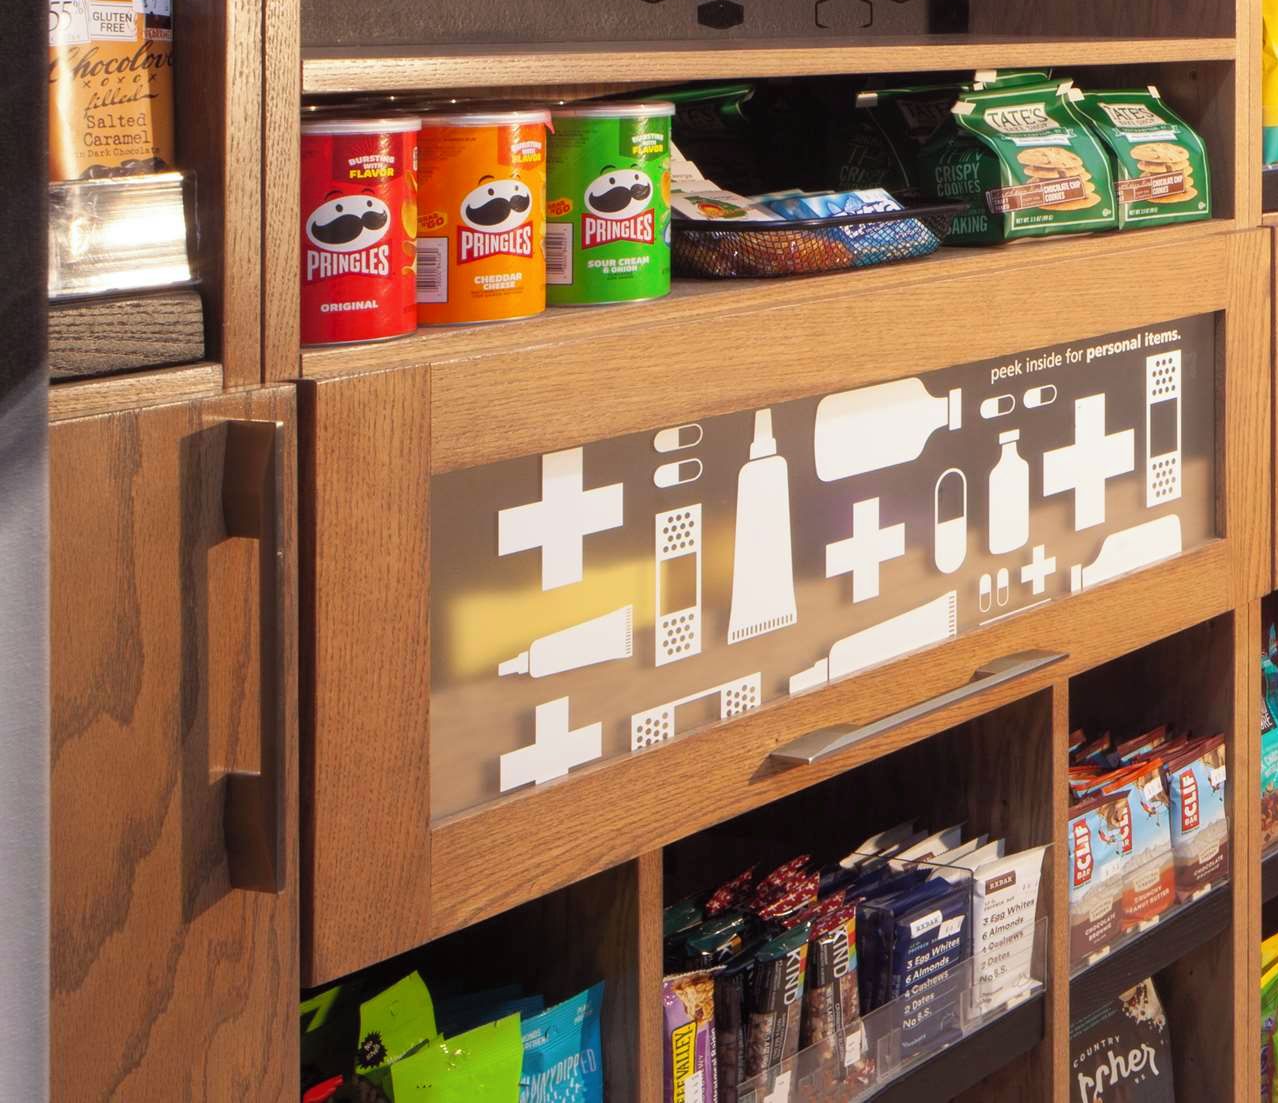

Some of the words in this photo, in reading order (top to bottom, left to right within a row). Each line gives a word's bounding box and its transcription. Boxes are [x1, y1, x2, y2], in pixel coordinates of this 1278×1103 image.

[92, 11, 132, 24] GLUTEN
[100, 23, 126, 34] FREE
[86, 113, 147, 130] Salted
[987, 107, 1049, 128] TATE'S
[83, 131, 151, 147] Caramel
[348, 154, 396, 167] BURSTING
[349, 167, 395, 180] FLAVOR
[936, 163, 982, 185] CRISPY
[584, 213, 653, 246] PRINGLES
[946, 214, 989, 237] AKING
[460, 225, 532, 261] PRINGLES
[306, 244, 390, 282] PRINGLES
[587, 259, 617, 269] SOUR
[618, 256, 650, 267] CREAM
[474, 272, 523, 285] CHEDDAR
[483, 282, 516, 291] CHEESE
[320, 300, 379, 313] ORIGINAL
[990, 361, 1023, 385] peek
[1026, 353, 1063, 374] inside
[1065, 347, 1084, 364] for
[1086, 333, 1142, 363] personal
[1144, 328, 1182, 347] items.
[1182, 776, 1198, 817] CLIF
[1184, 815, 1199, 827] BAR
[1075, 824, 1092, 872] CLIF
[1077, 868, 1091, 880] BAR
[1194, 853, 1224, 877] CHOCOLATE
[990, 908, 1006, 925] Egg
[1007, 897, 1036, 916] Whites
[989, 916, 1025, 938] Almonds
[1085, 913, 1116, 937] CHOCOLATE
[833, 924, 850, 979] KIND
[906, 959, 913, 971] 3
[914, 952, 931, 968] Egg
[931, 936, 962, 957] Whites
[988, 950, 1011, 966] Dates
[783, 947, 802, 1006] KIND
[905, 973, 913, 985] 6
[913, 956, 950, 981] Almonds
[979, 972, 994, 984] No
[911, 970, 950, 995] Cashews
[912, 992, 936, 1010] Dates
[902, 1016, 918, 1030] No
[1072, 1034, 1121, 1069] COUNTRY
